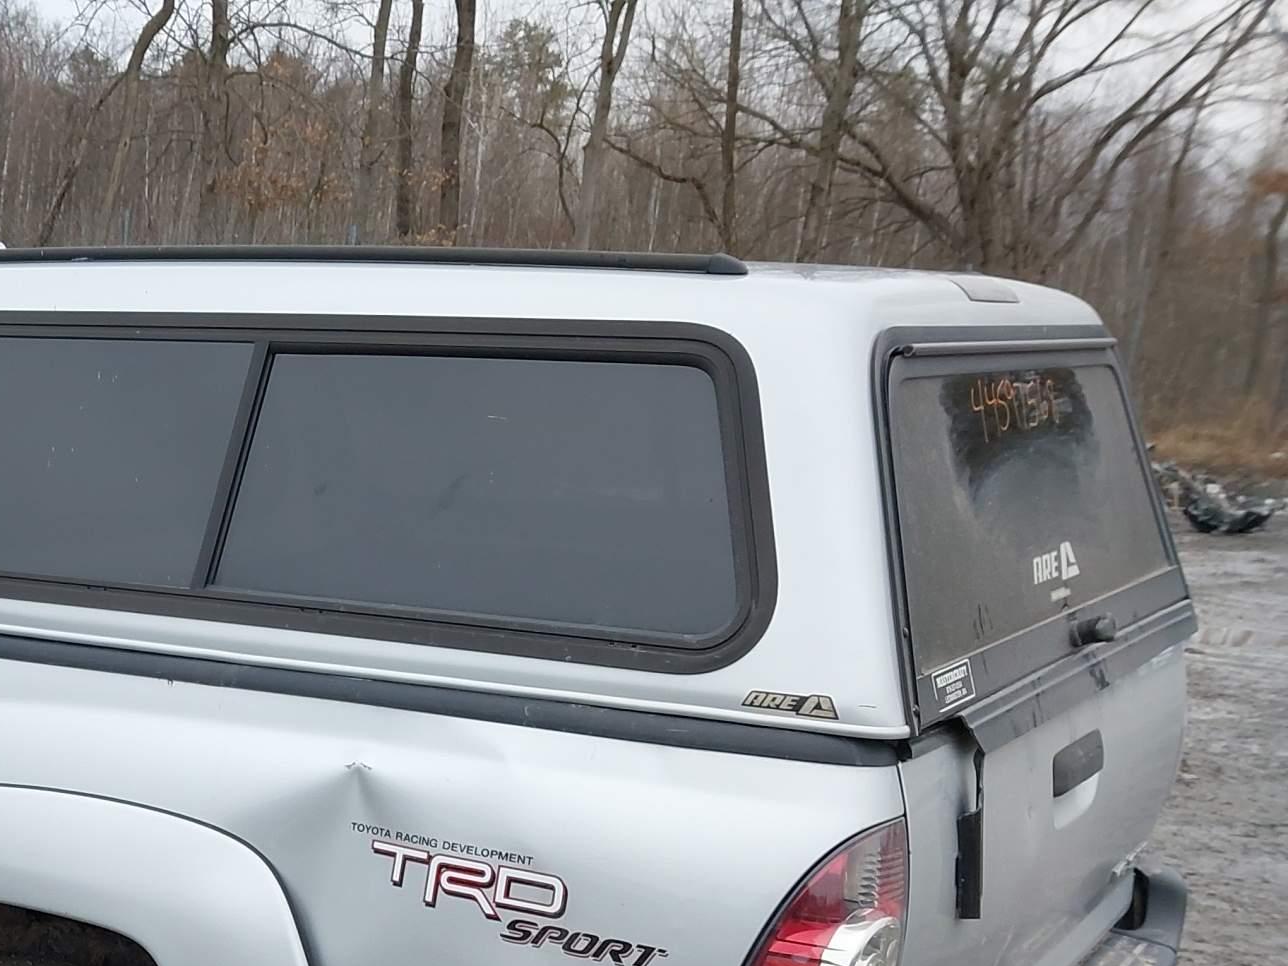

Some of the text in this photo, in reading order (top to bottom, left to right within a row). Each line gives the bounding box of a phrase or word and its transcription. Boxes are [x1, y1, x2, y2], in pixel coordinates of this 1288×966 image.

[351, 822, 534, 866] TOYOTA RACING DEVELOPMENT
[371, 839, 568, 922] TRD
